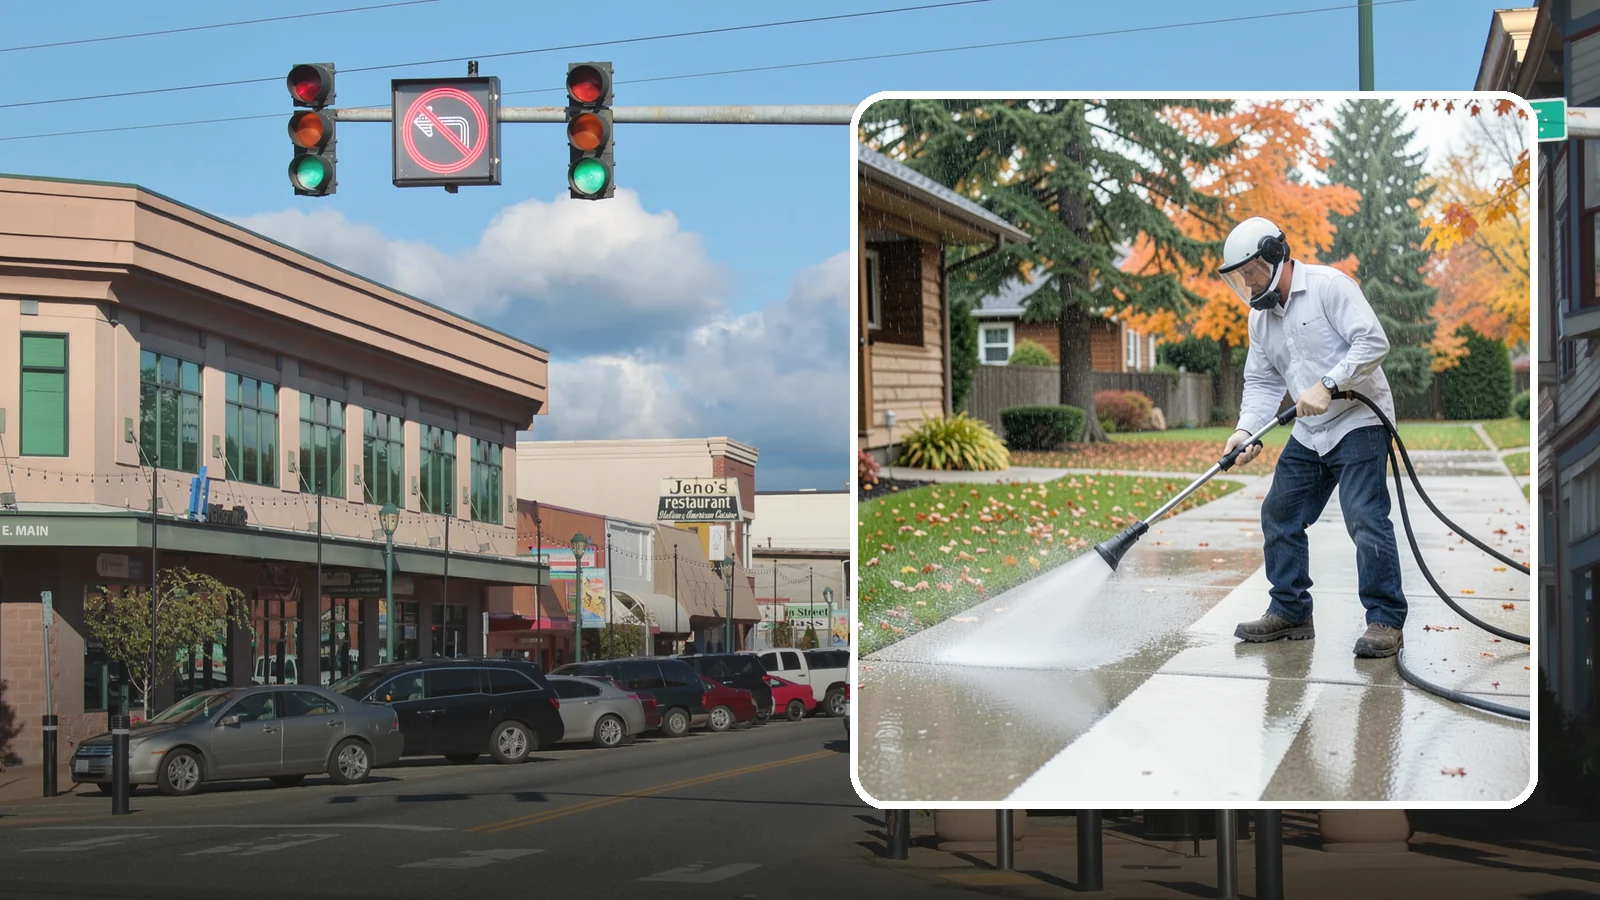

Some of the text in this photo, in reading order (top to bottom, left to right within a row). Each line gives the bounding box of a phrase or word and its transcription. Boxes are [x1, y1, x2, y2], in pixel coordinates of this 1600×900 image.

[669, 479, 728, 495] Jeno's
[665, 496, 731, 509] restaurant
[658, 509, 682, 520] Italian
[686, 509, 714, 519] American
[715, 509, 737, 519] Cuisine
[2, 525, 49, 536] E. MAIN
[797, 607, 829, 617] Street
